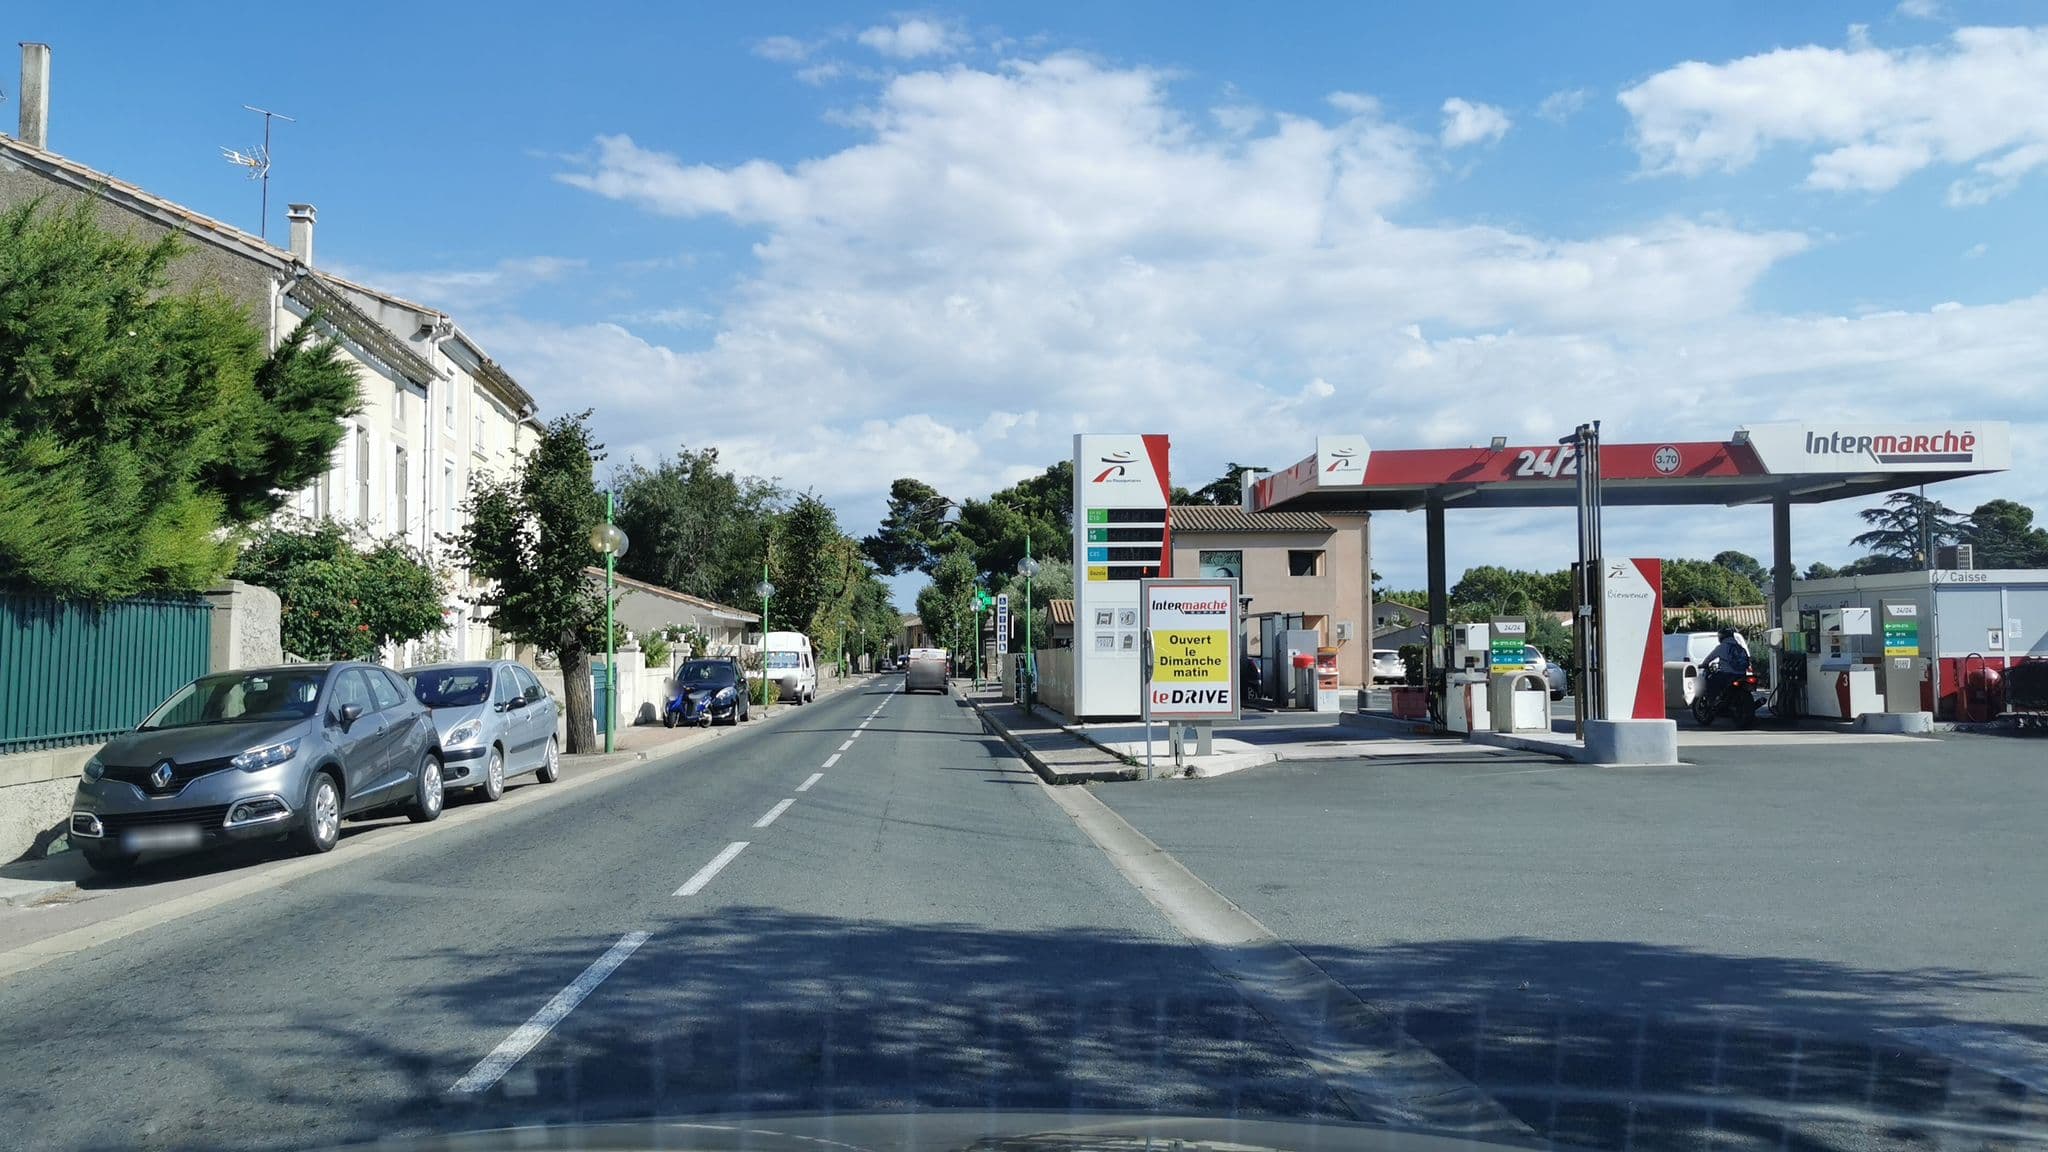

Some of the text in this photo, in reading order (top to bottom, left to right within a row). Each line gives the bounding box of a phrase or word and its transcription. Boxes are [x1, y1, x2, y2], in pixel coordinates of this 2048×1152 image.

[1805, 430, 1976, 464] Intermarché
[1516, 447, 1578, 477] 24/2
[1656, 455, 1678, 464] 3.70
[1950, 572, 1987, 582] Caisse
[1169, 635, 1212, 645] Ouvert
[1185, 647, 1196, 657] le
[1160, 656, 1222, 666] Dimanche
[1173, 667, 1209, 677] matin
[1842, 674, 1849, 687] 3
[1152, 690, 1229, 704] le DRIVE
